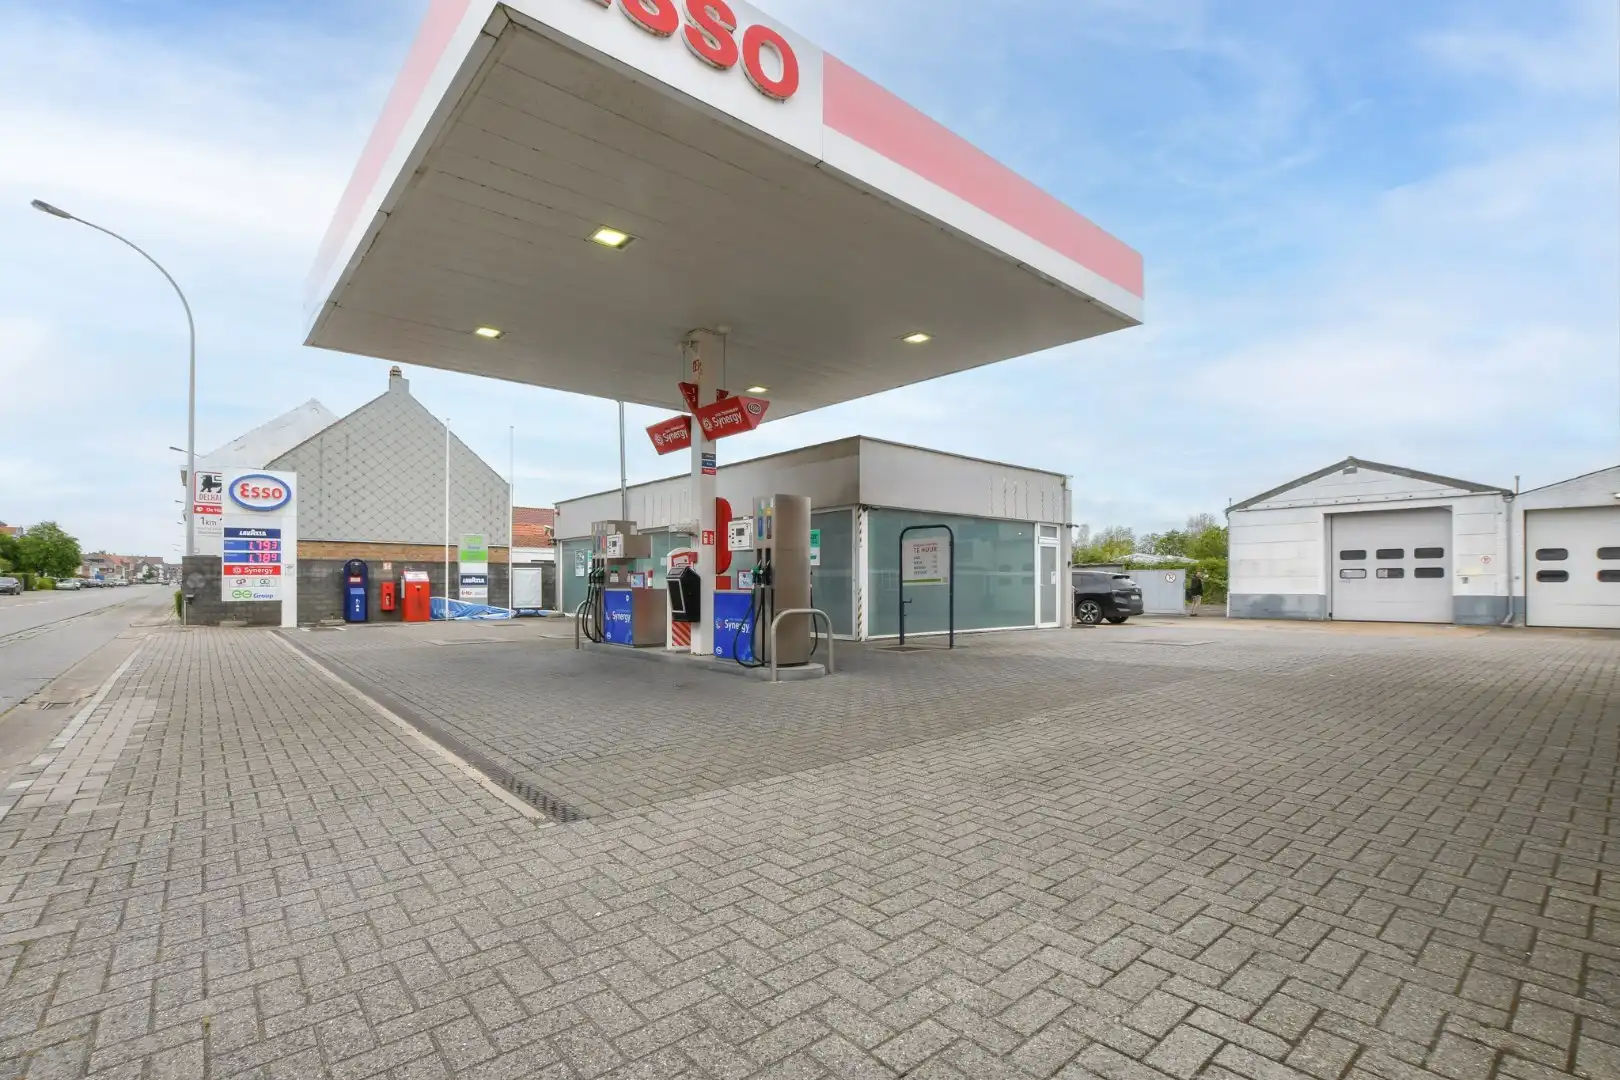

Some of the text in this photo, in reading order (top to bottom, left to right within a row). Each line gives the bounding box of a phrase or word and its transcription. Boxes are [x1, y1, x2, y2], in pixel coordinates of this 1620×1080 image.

[712, 412, 742, 428] Synergy
[662, 428, 688, 443] Synergy
[612, 610, 631, 623] Synergy
[724, 619, 750, 633] Synegy
